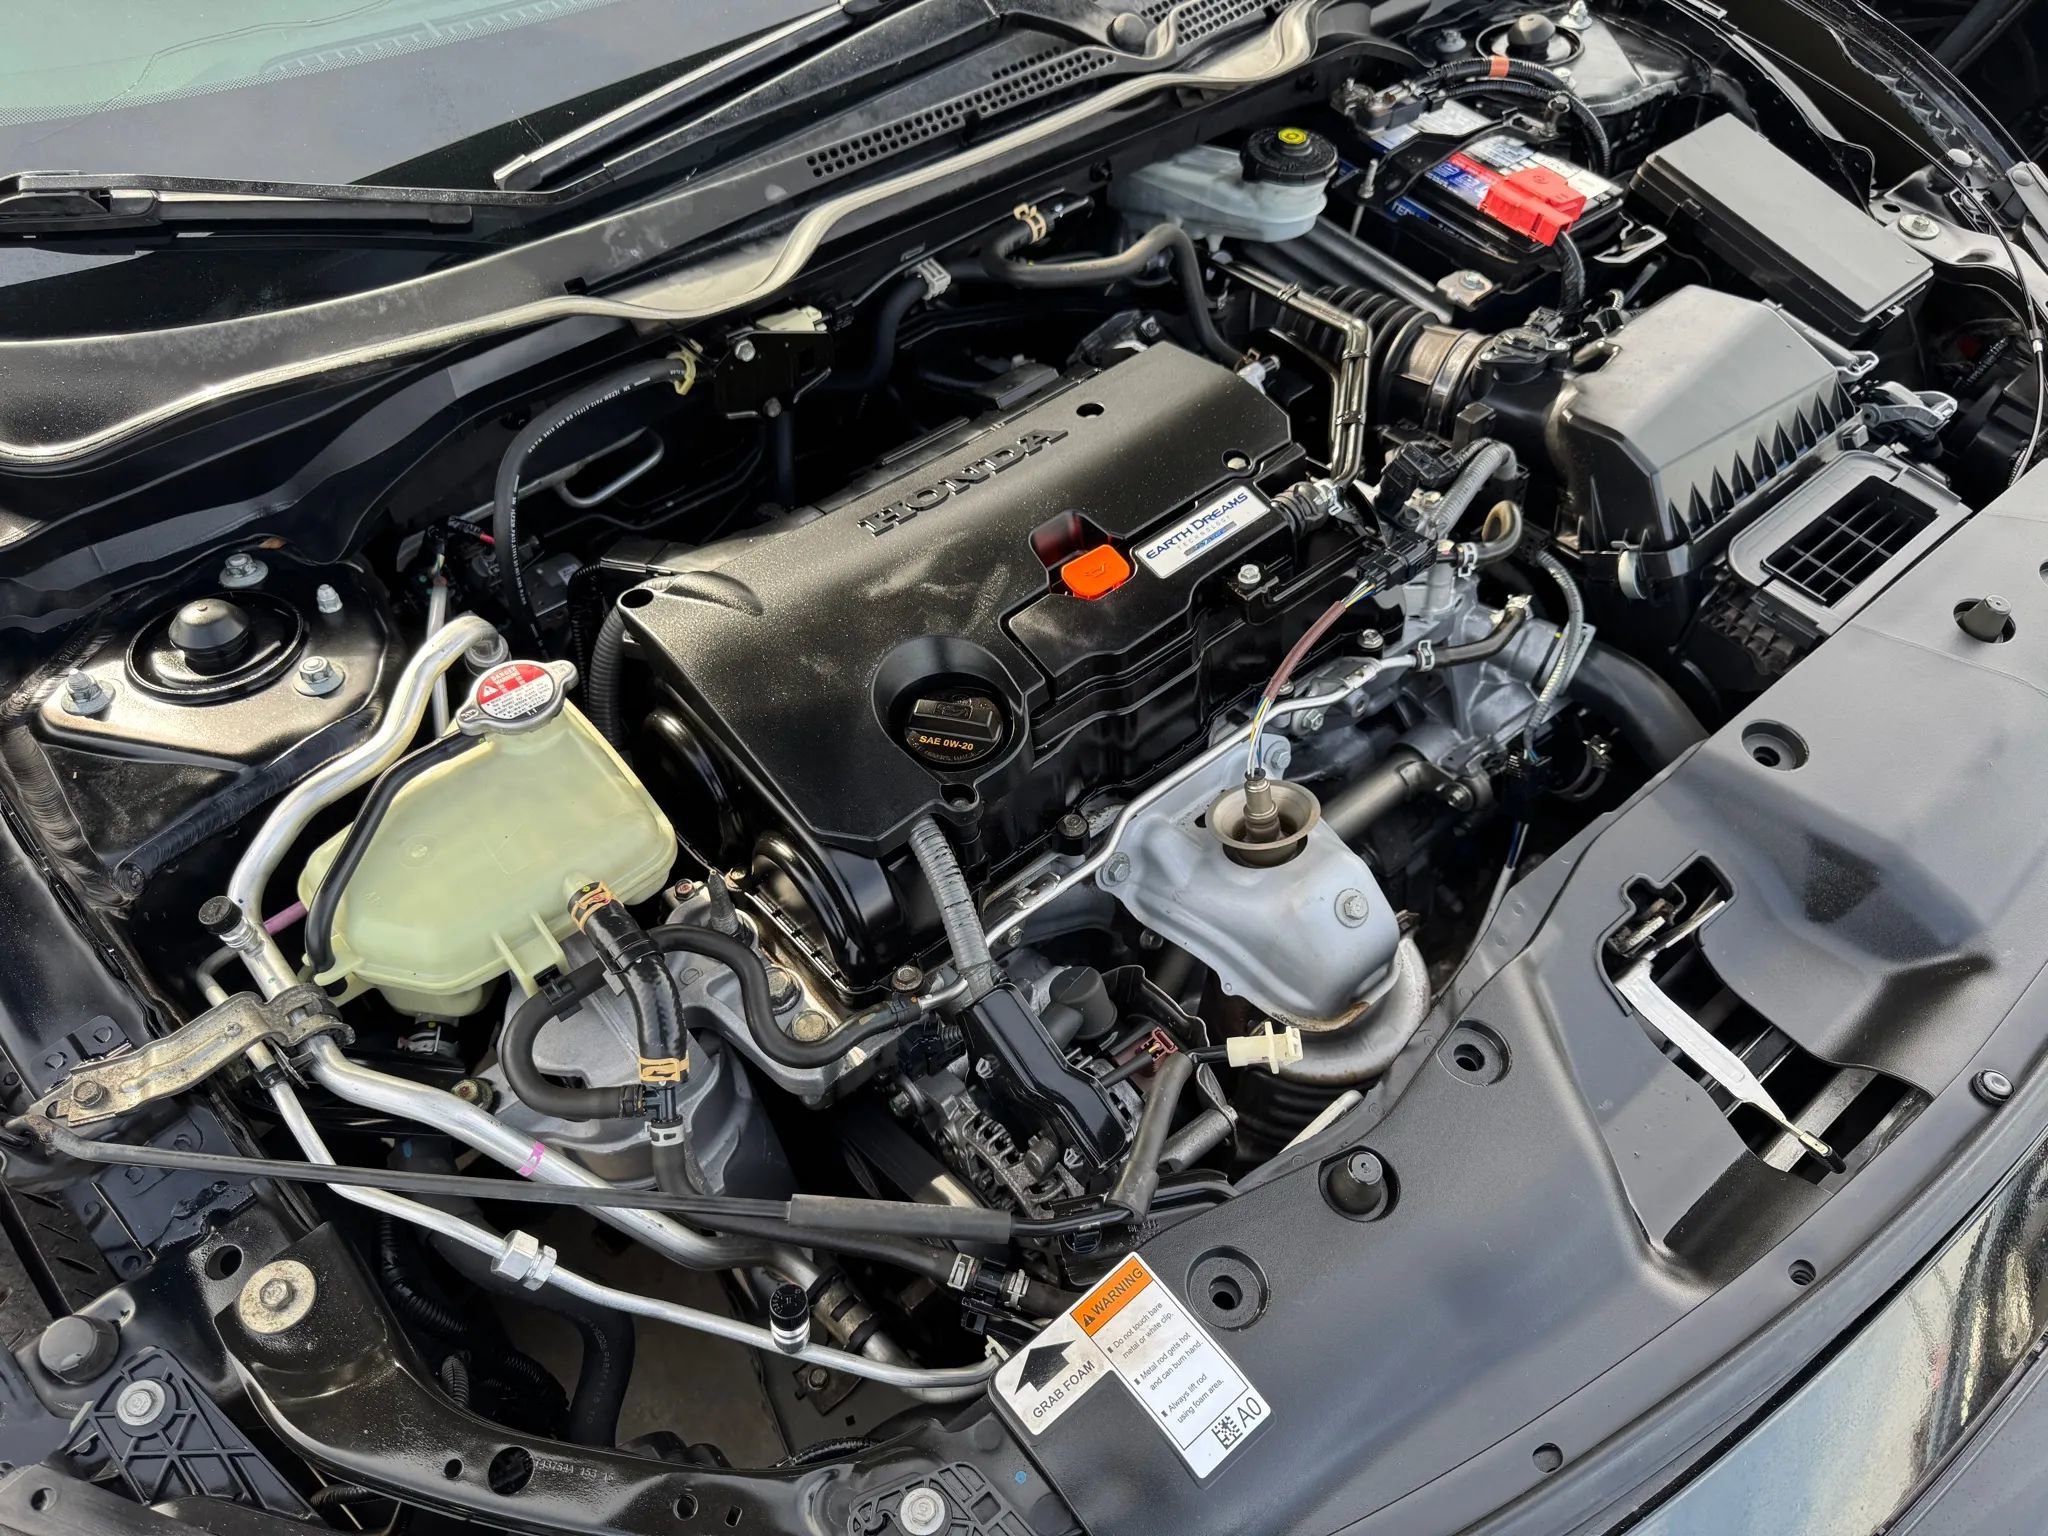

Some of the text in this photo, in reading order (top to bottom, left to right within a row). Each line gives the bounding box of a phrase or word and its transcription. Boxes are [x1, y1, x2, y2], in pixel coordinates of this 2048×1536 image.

[856, 429, 1069, 537] HONDA
[1146, 528, 1193, 560] EARTH
[1190, 492, 1249, 530] DREAMS
[919, 735, 974, 751] SAE 0W-20
[1091, 1268, 1143, 1315] WARNING
[1113, 1303, 1163, 1348] Do not touch bare
[1123, 1312, 1174, 1359] metal or white clip.
[1140, 1332, 1191, 1380] Metal rod gets hot
[1150, 1340, 1203, 1391] and can burn hand.
[1033, 1360, 1095, 1418] GRAB FOAM
[1168, 1373, 1207, 1412] Always lift rod
[1177, 1379, 1224, 1423] using foam area.
[1237, 1397, 1261, 1428] A0
